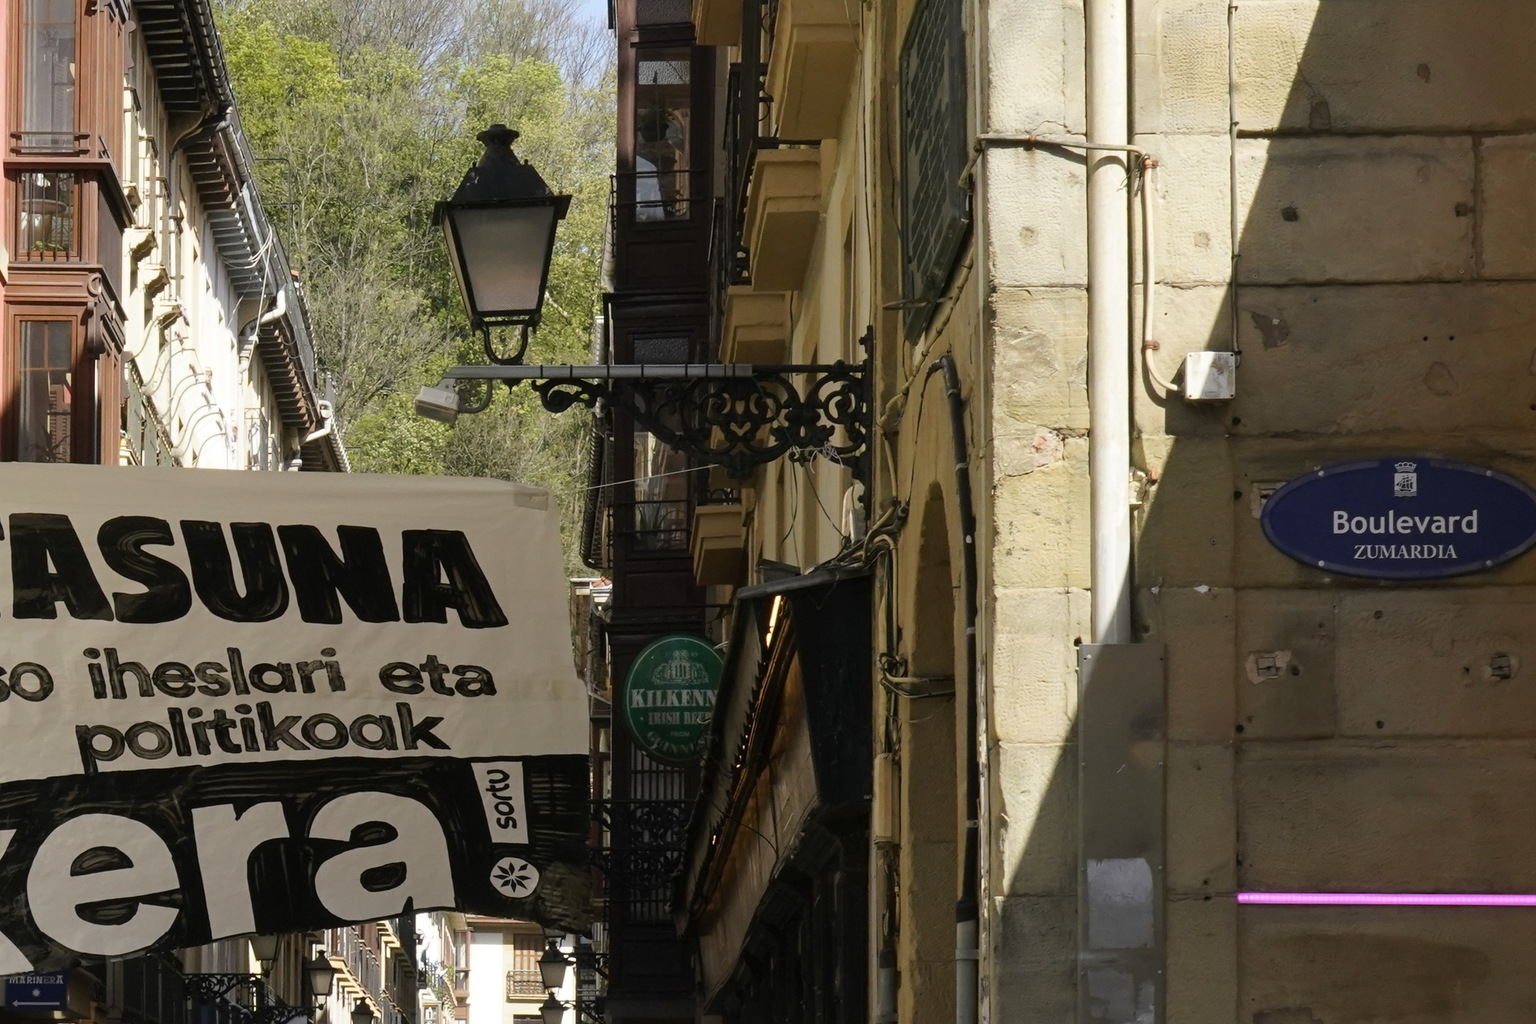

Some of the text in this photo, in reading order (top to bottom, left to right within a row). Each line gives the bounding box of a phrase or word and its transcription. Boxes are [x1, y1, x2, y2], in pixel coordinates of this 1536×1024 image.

[1333, 509, 1478, 534] Boulevard
[1354, 544, 1458, 560] ZUMARDIA
[82, 647, 347, 700] iheslari
[379, 654, 498, 698] eta
[631, 688, 718, 708] KILKENN
[648, 712, 680, 725] IRISH
[75, 702, 452, 775] politikoak
[486, 768, 518, 831] sortu
[9, 974, 64, 984] MARINERA
